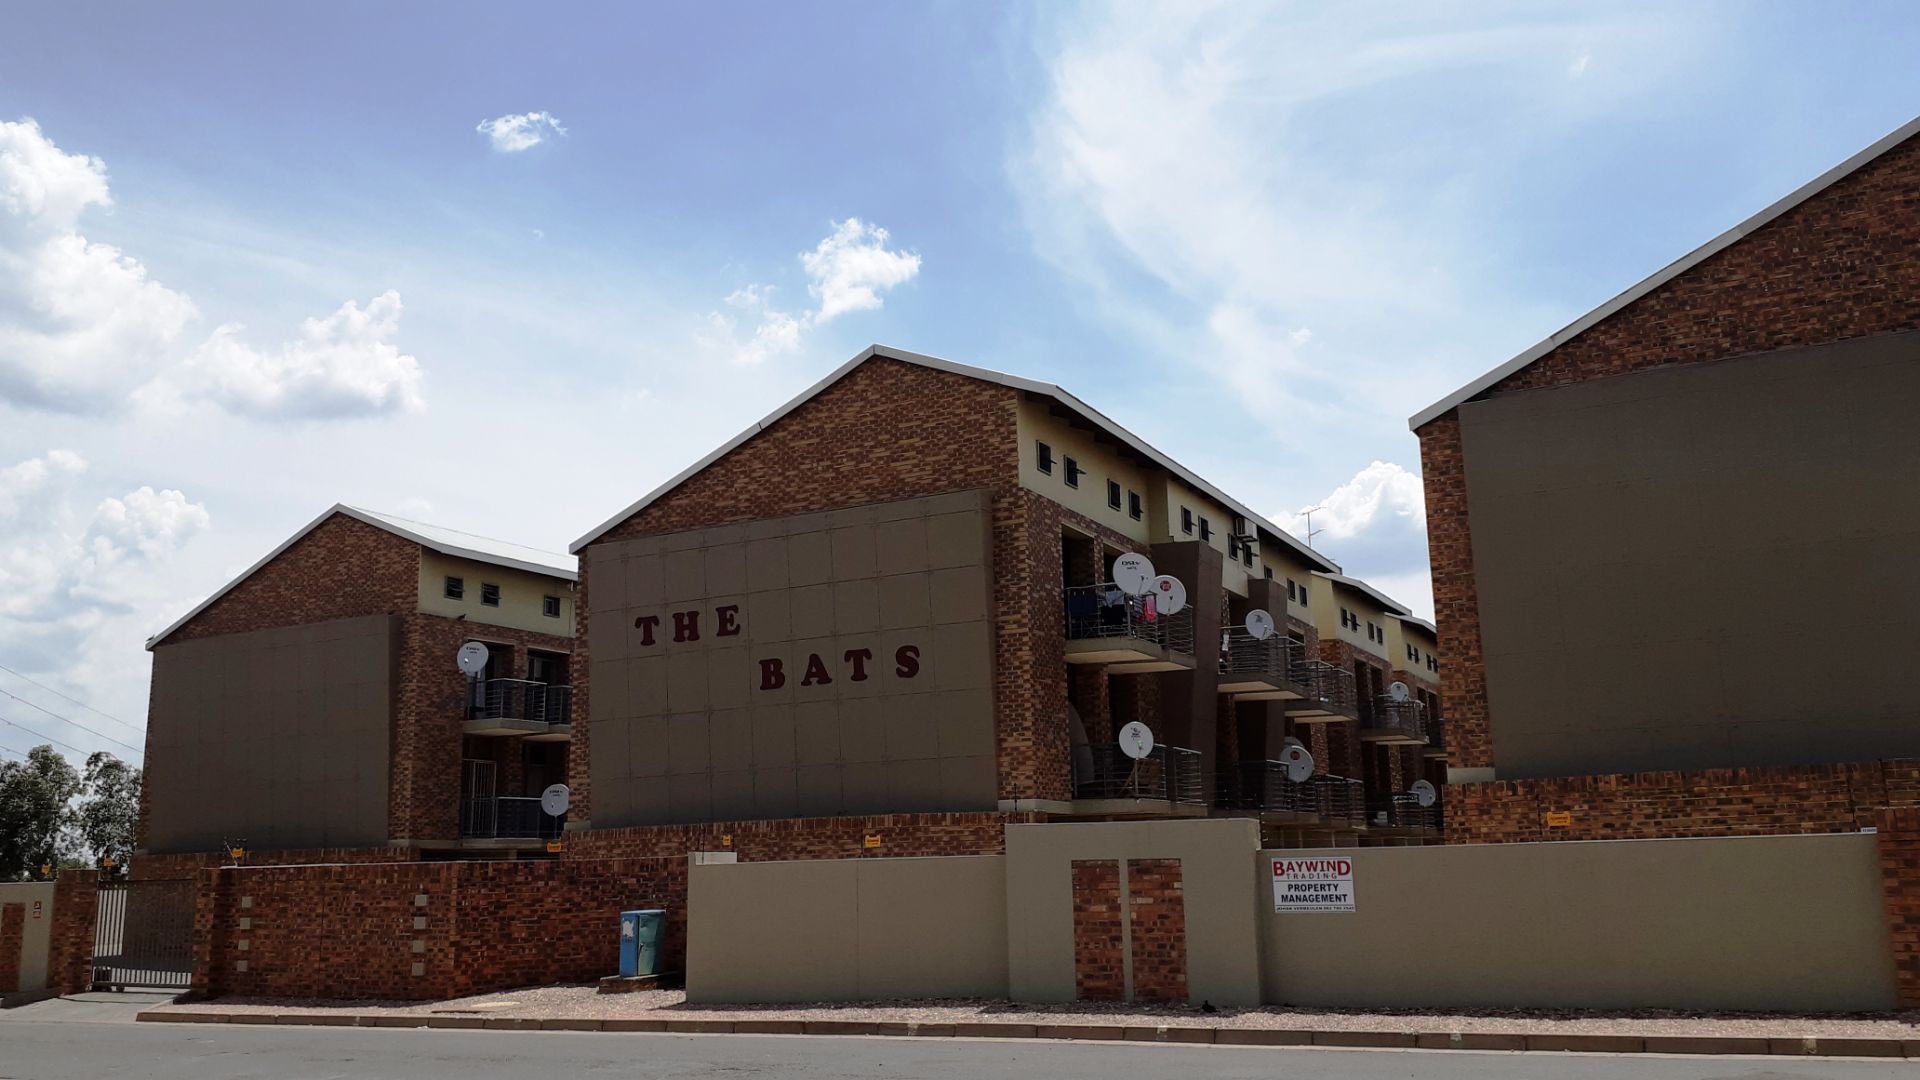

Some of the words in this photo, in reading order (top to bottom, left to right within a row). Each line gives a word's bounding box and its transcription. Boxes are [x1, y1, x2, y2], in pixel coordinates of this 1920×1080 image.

[634, 604, 741, 647] THE
[758, 645, 920, 690] BATS
[1273, 860, 1351, 877] BAYWIND
[1286, 872, 1338, 880] TRADING
[1287, 883, 1339, 892] PROPERTY
[1281, 894, 1348, 903] MANAGEMENT
